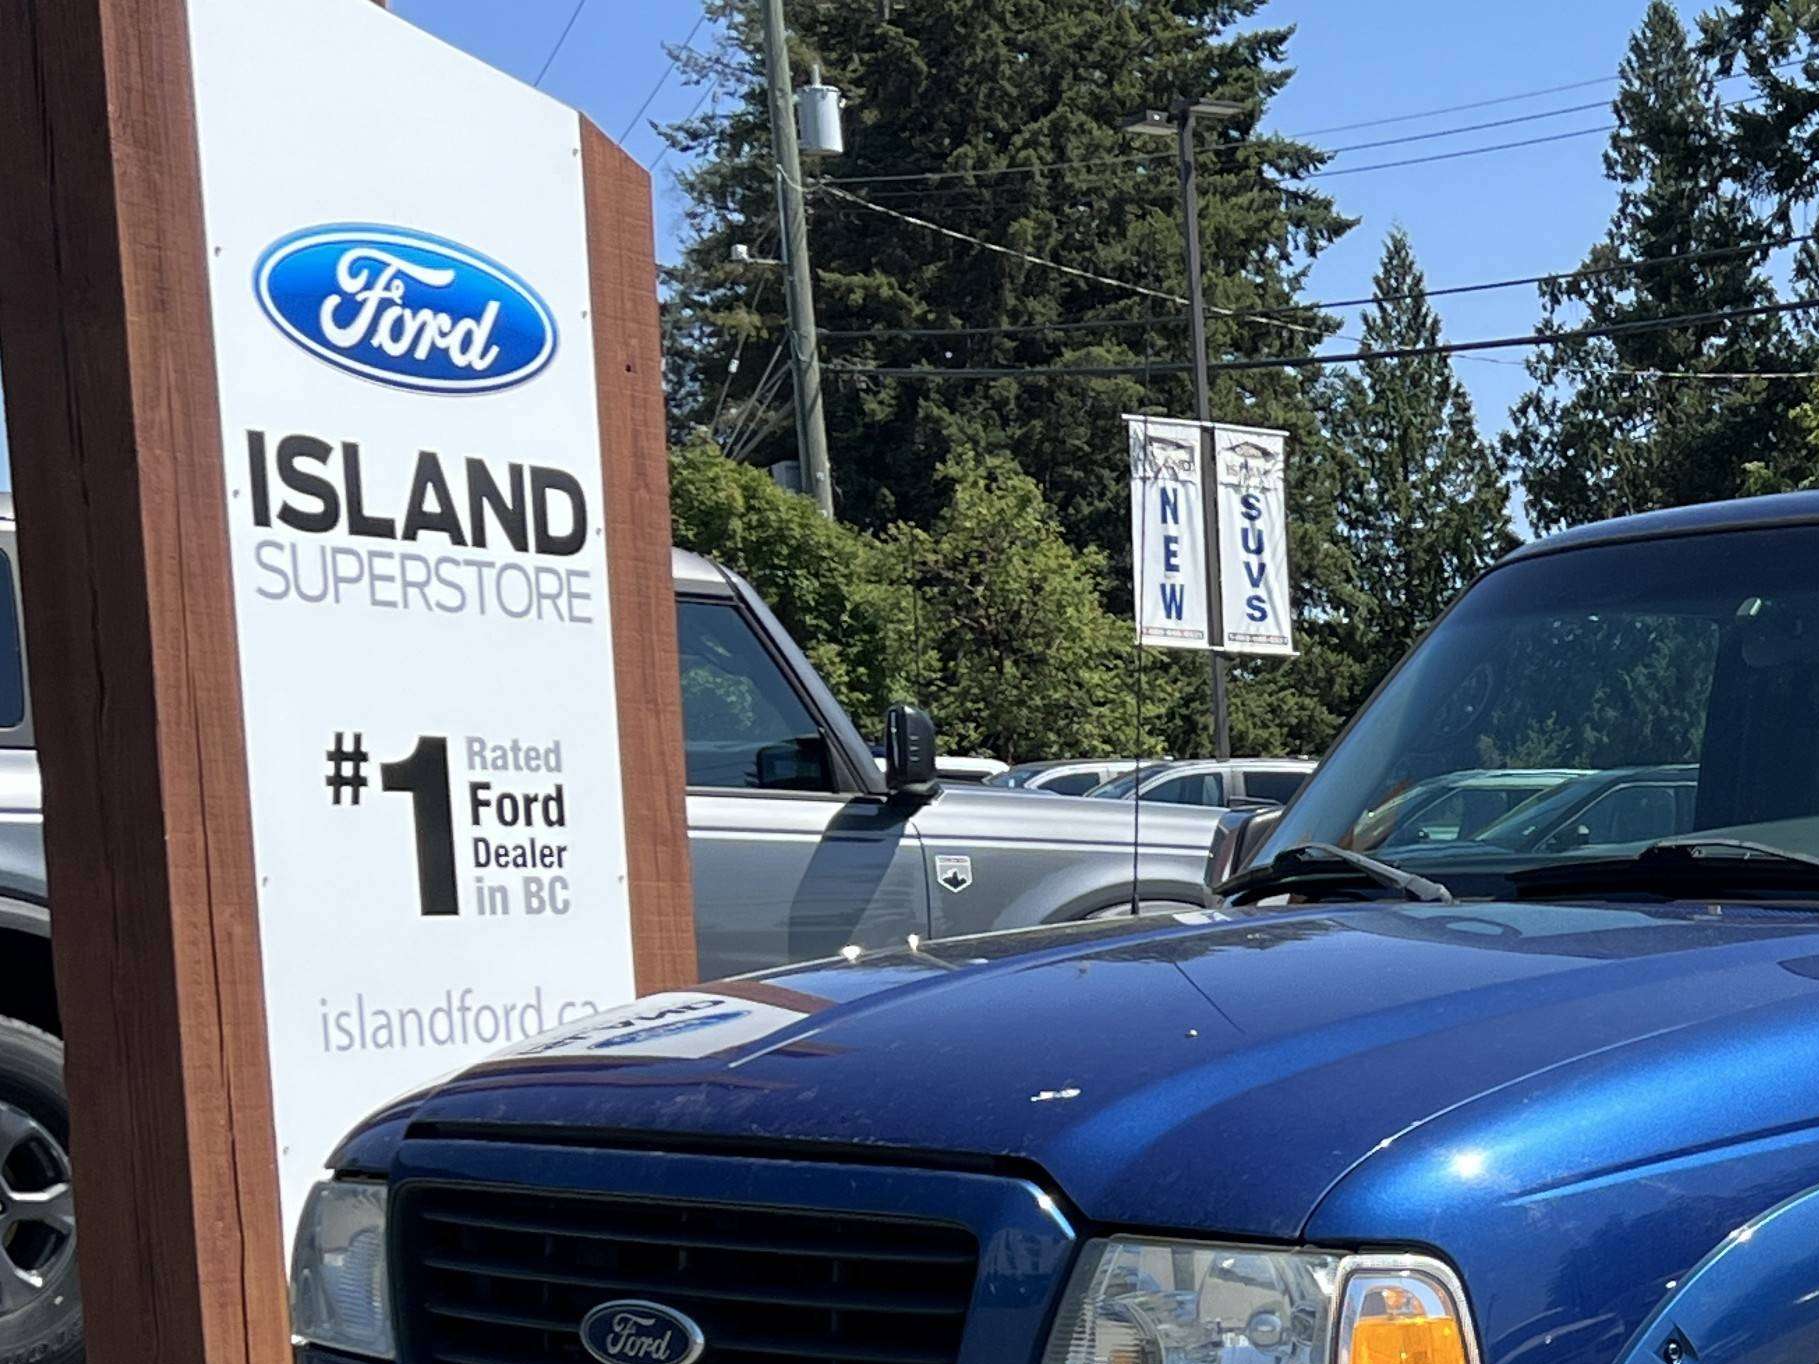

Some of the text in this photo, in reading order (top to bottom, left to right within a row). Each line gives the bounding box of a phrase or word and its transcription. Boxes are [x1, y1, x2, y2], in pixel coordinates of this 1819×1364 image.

[320, 247, 501, 372] Ford
[246, 430, 588, 557] ISLAND
[255, 540, 593, 624] SUPERSTORE
[1160, 487, 1184, 621] NEW
[1240, 494, 1267, 622] SUVS
[466, 737, 562, 773] Rated
[469, 782, 566, 828] Ford
[474, 838, 567, 869] Dealer
[476, 876, 571, 915] in BC
[606, 1313, 672, 1360] Ford
